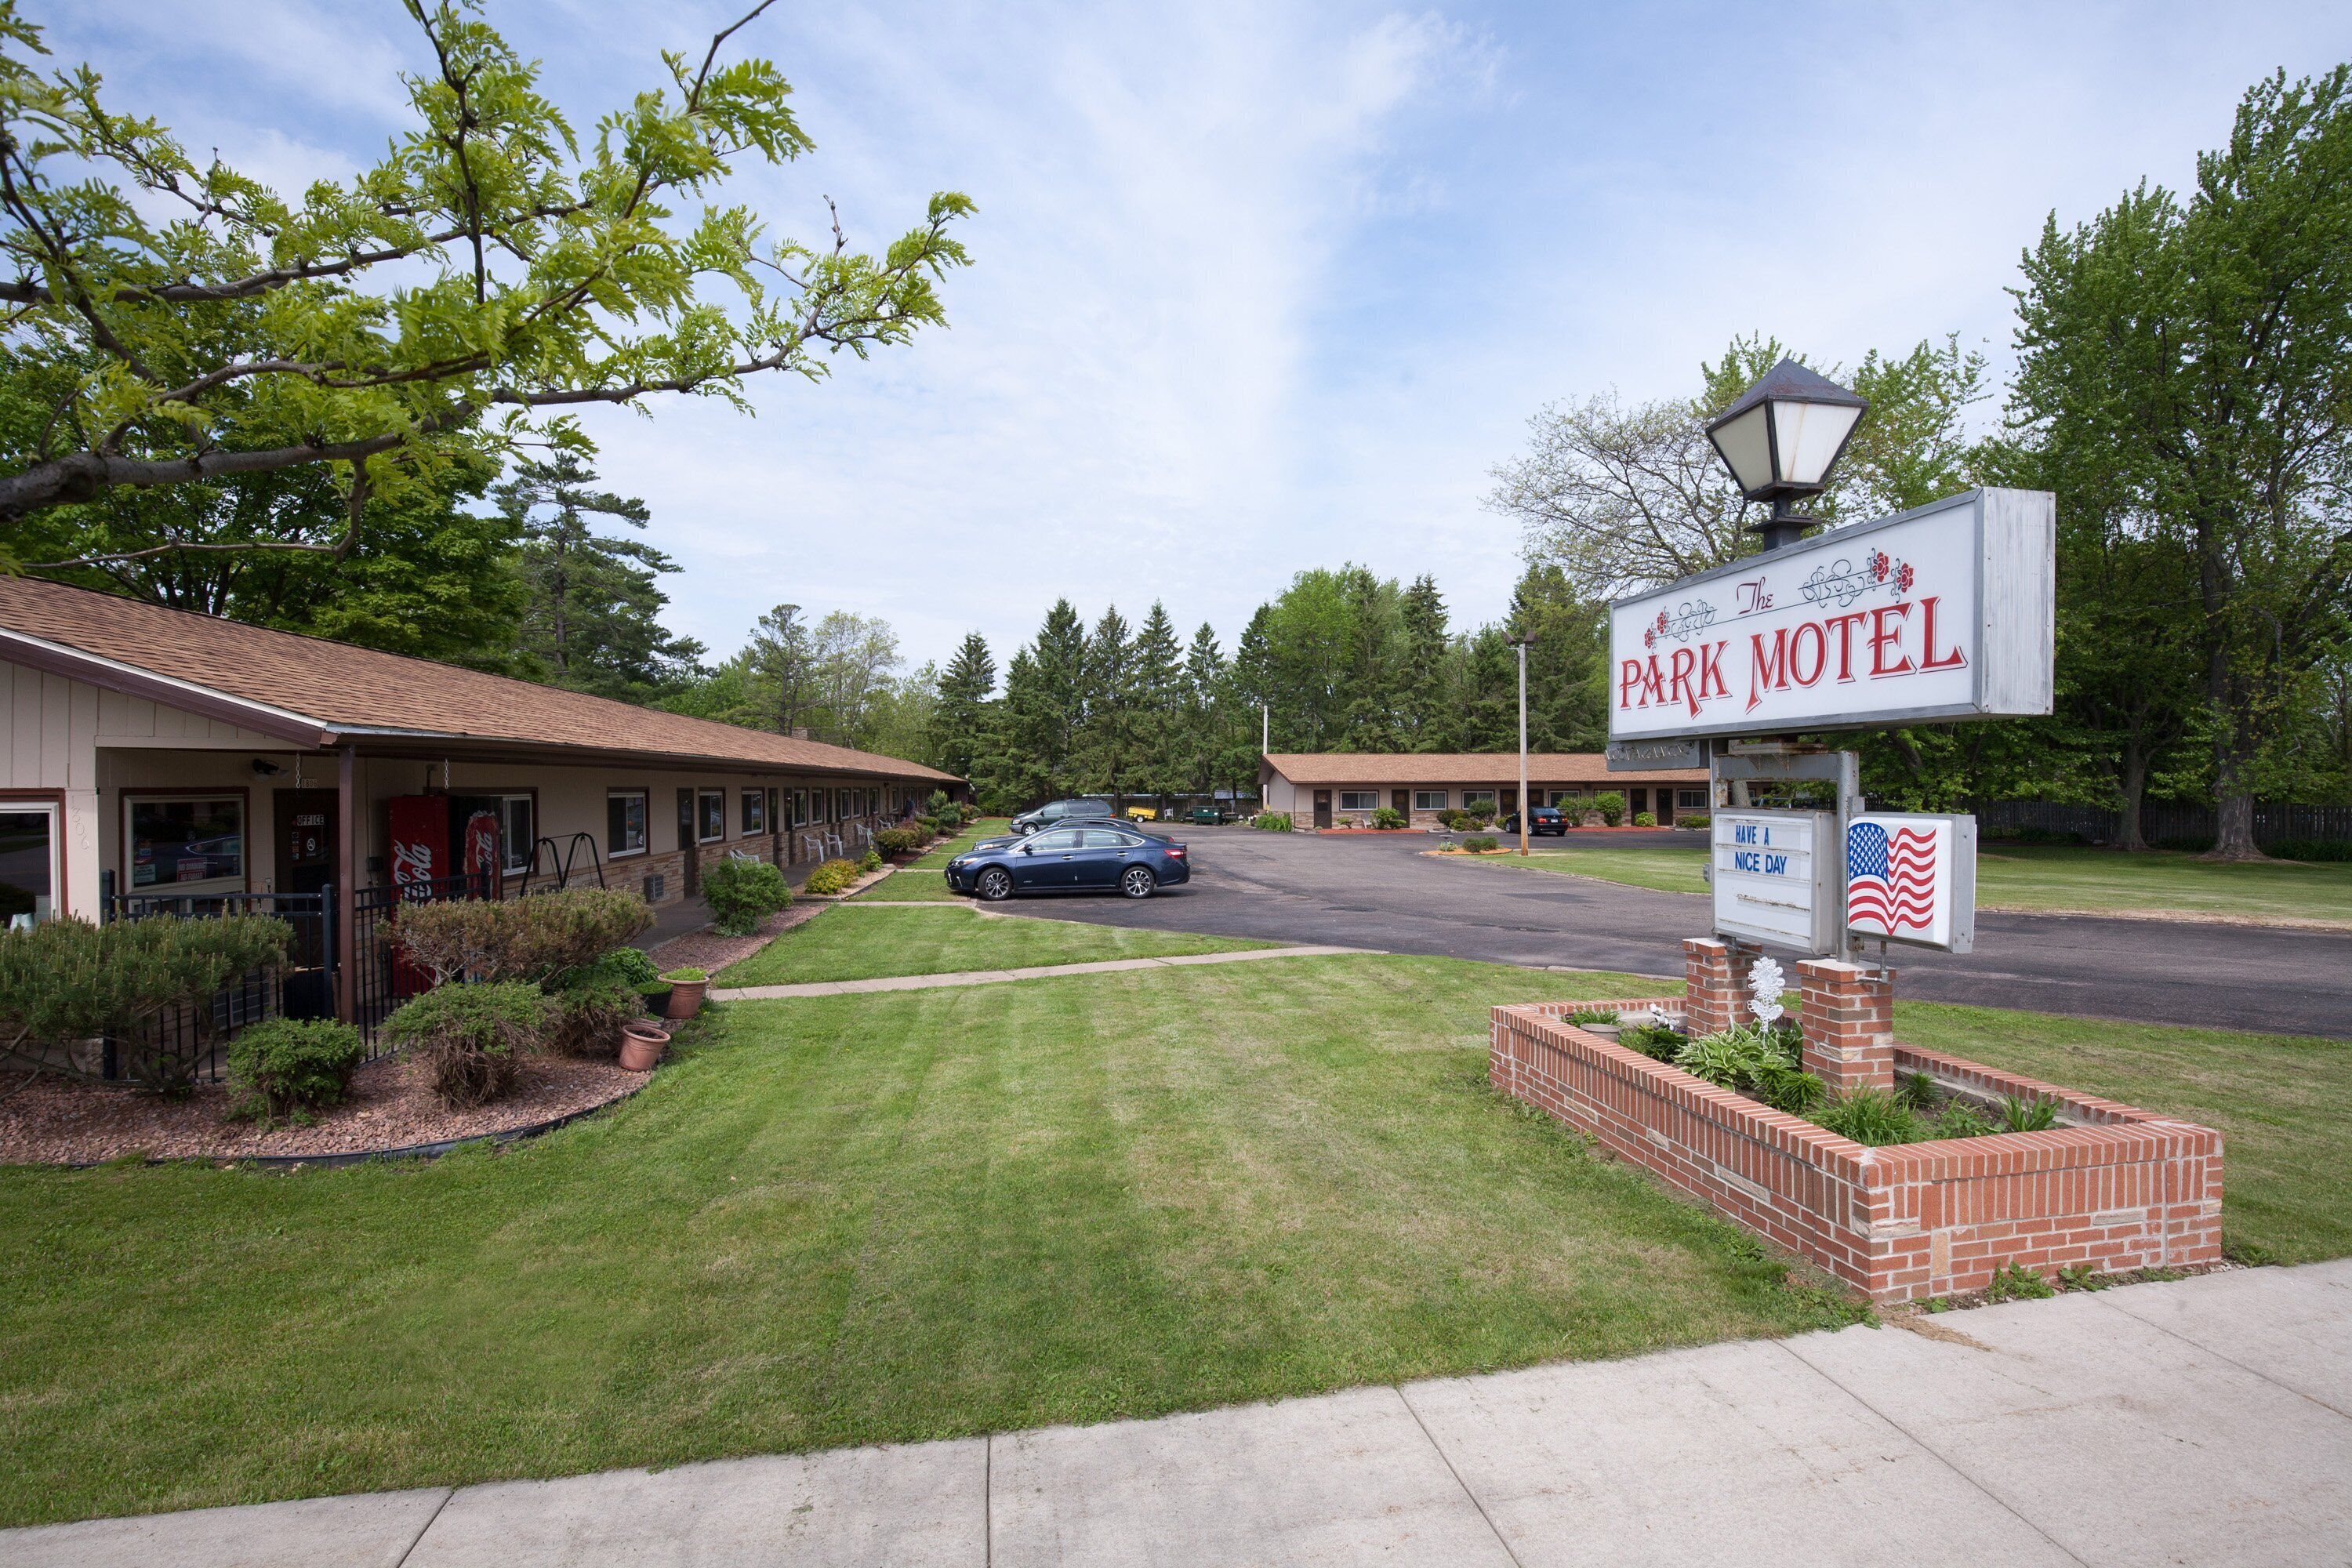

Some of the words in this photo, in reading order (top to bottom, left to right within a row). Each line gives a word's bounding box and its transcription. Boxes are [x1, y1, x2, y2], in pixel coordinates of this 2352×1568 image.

[1737, 576, 1775, 615] The
[1619, 641, 1733, 719] PARK
[1745, 596, 1969, 714] MOTEL
[297, 815, 324, 826] OFFICE
[1735, 825, 1757, 844] HAVE
[1763, 827, 1769, 845] A
[1735, 851, 1760, 872] NICE
[1765, 855, 1788, 874] DAY
